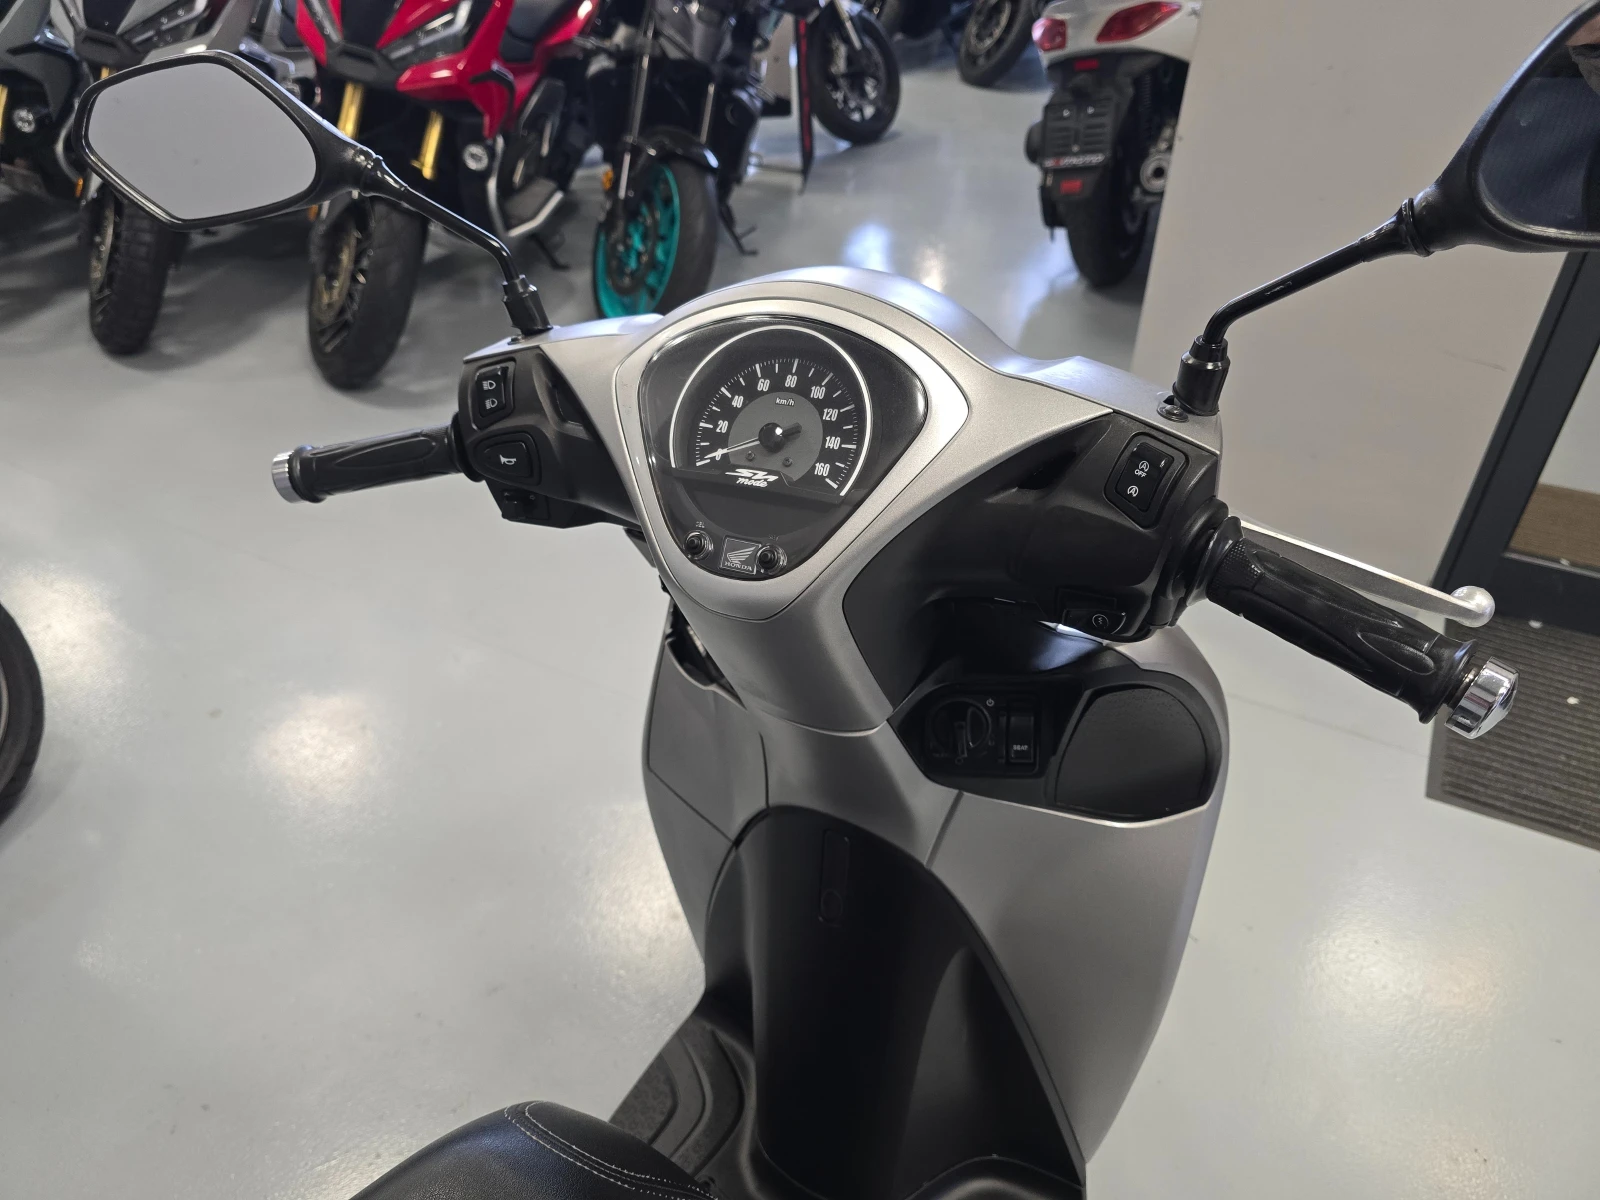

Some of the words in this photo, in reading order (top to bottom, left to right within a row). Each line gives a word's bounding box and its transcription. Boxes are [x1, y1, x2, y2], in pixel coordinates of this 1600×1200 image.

[757, 378, 770, 392] 60
[785, 375, 797, 388] 80
[810, 386, 826, 399] 100
[732, 396, 744, 408] 40
[776, 398, 794, 406] km/h
[822, 408, 838, 421] 120
[716, 420, 728, 433] 20
[825, 436, 840, 450] 140
[814, 462, 830, 476] 160
[1134, 469, 1147, 478] OFF
[736, 477, 768, 488] mode
[724, 562, 752, 571] HONDA
